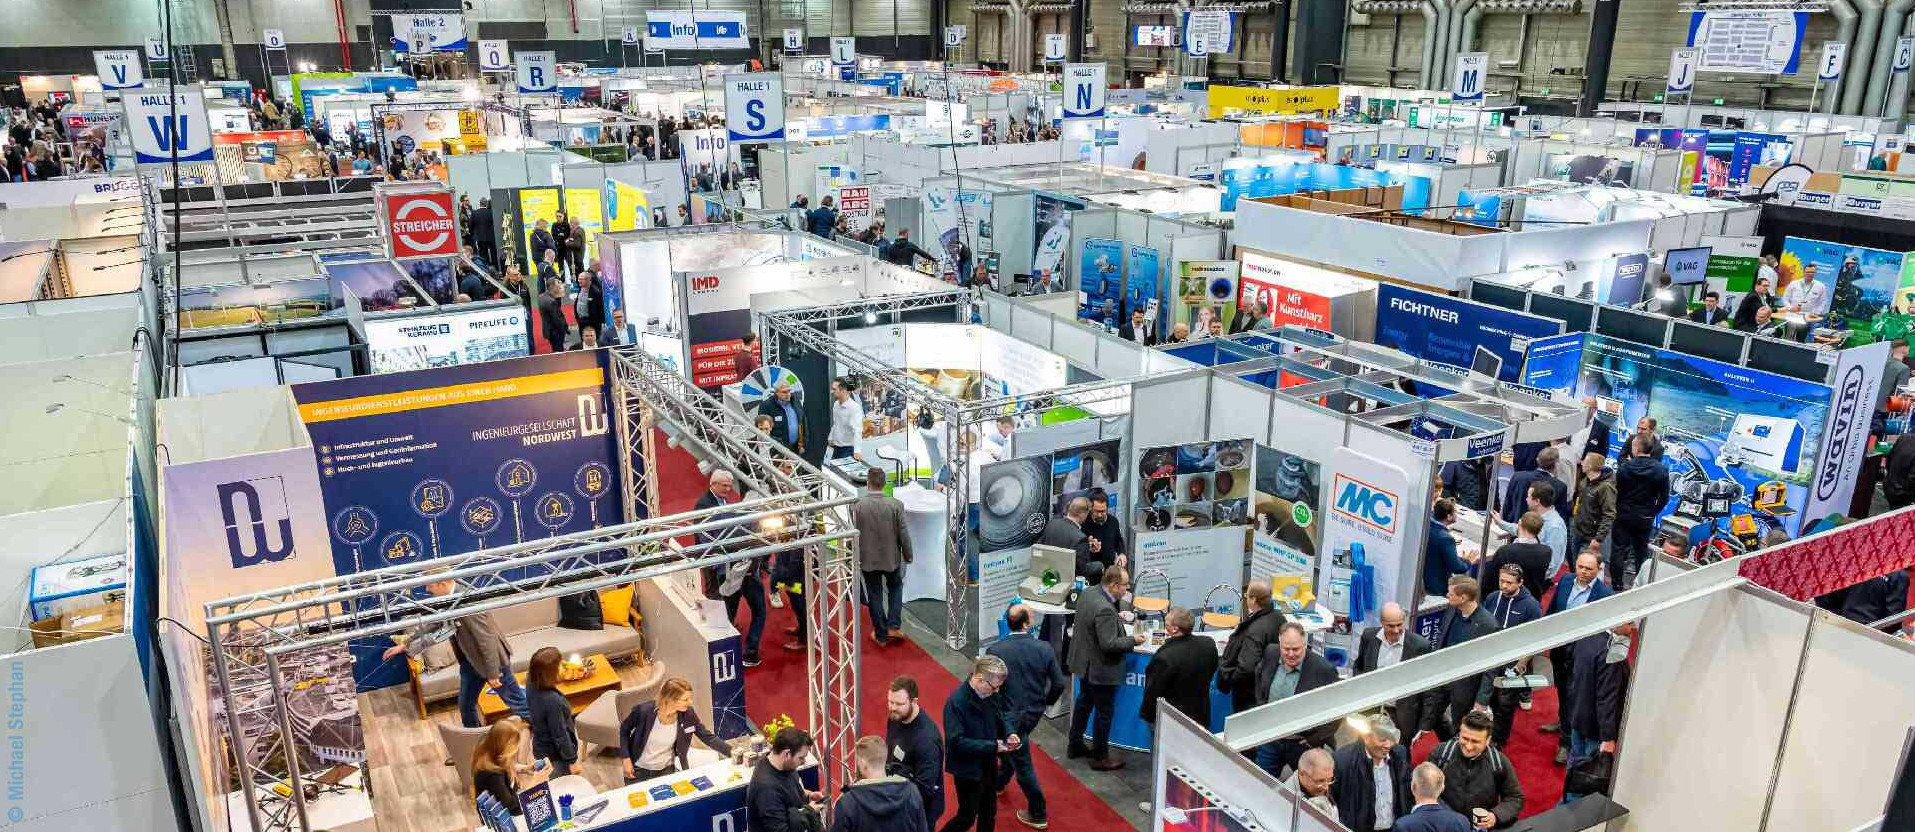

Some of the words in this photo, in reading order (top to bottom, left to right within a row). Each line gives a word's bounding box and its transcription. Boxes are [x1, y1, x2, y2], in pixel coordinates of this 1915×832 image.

[413, 18, 435, 27] Halle
[438, 18, 445, 27] 2
[672, 25, 694, 36] Info
[416, 41, 424, 52] P
[790, 36, 797, 47] H
[1196, 41, 1202, 52] E
[154, 45, 165, 57] U
[489, 51, 500, 66] Q
[840, 47, 846, 61] L
[1827, 55, 1836, 73] F
[111, 64, 126, 84] V
[530, 66, 544, 87] R
[1073, 69, 1093, 77] HALLE
[1677, 63, 1688, 85] J
[737, 82, 763, 92] HALLE
[765, 82, 770, 91] 1
[1461, 69, 1478, 93] M
[141, 96, 175, 106] HALL
[1077, 83, 1092, 109] N
[746, 99, 766, 131] S
[146, 114, 188, 152] W
[695, 135, 725, 151] Info
[393, 219, 454, 233] STREICHER
[1683, 261, 1698, 271] VAG
[692, 276, 719, 290] IMD
[1287, 292, 1301, 305] Mit
[1279, 303, 1324, 323] Kunstharz
[1390, 297, 1460, 324] FICHTNER
[469, 318, 507, 330] PIPELIFE
[472, 417, 576, 442] INGENIEURGESELLSCHAFT
[1822, 379, 1859, 489] wavin
[523, 429, 577, 446] NORDWEST
[1468, 433, 1505, 449] Veenker
[1336, 482, 1393, 526] MC
